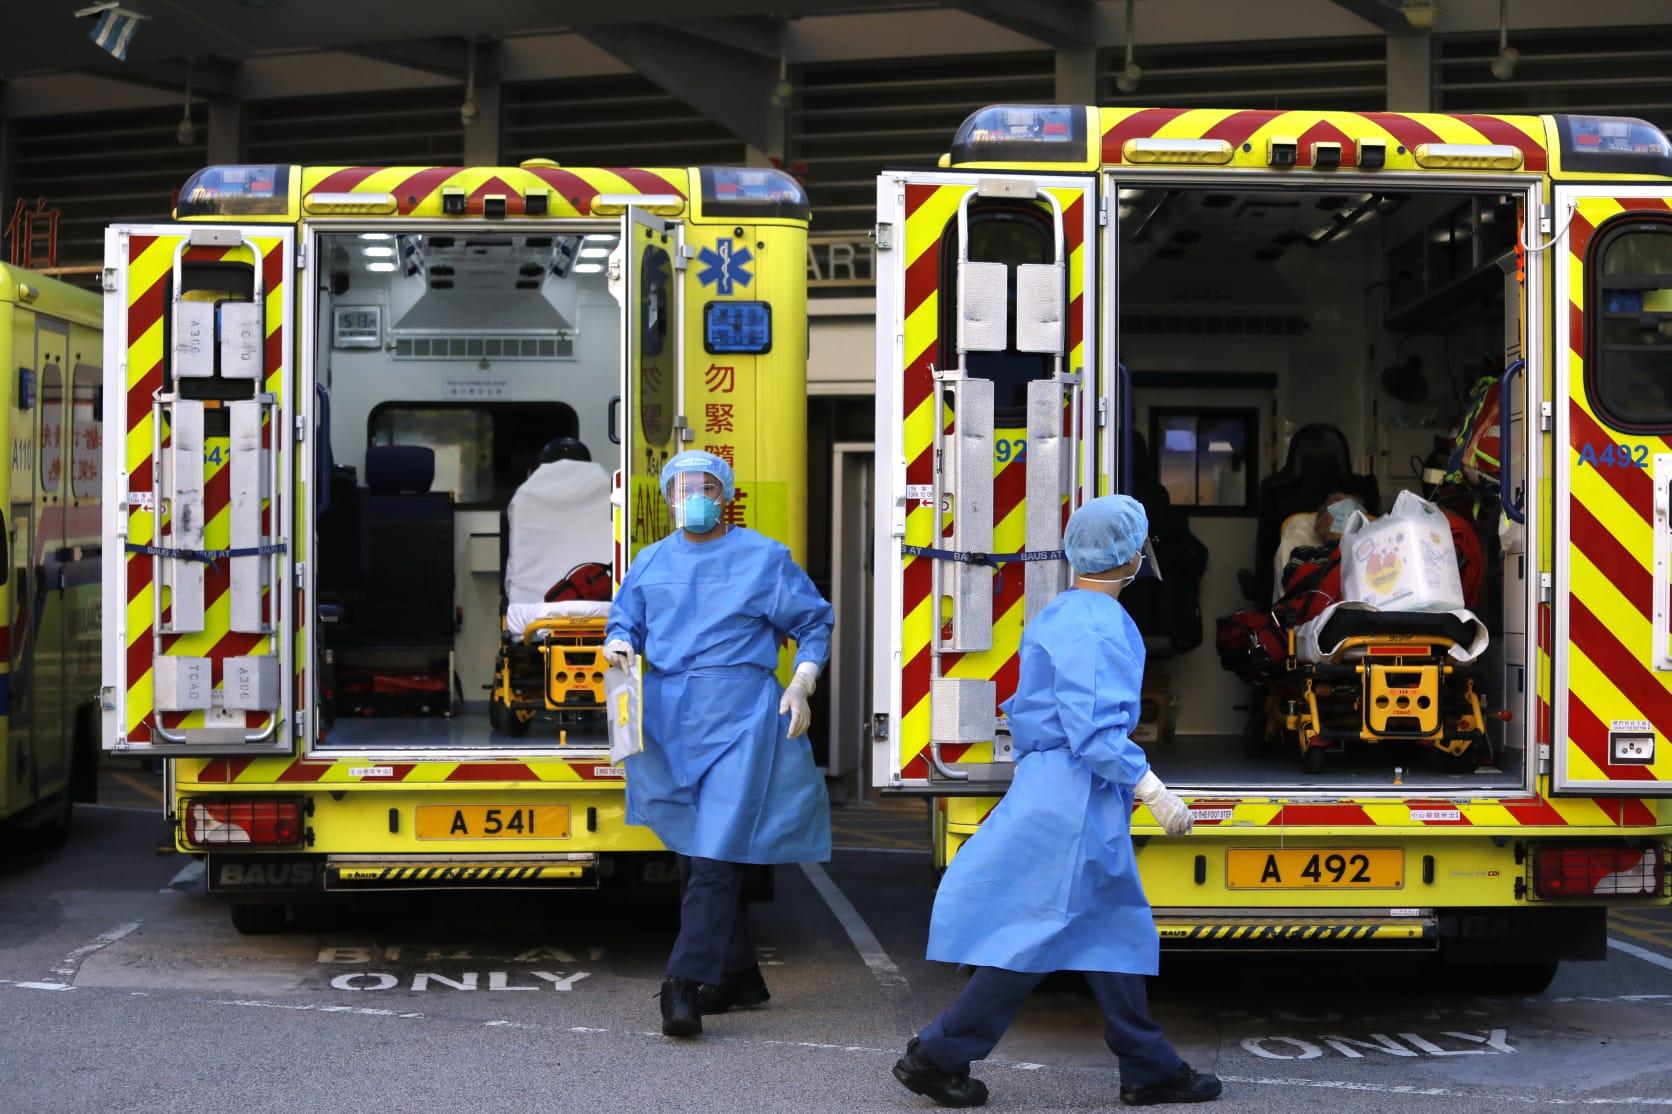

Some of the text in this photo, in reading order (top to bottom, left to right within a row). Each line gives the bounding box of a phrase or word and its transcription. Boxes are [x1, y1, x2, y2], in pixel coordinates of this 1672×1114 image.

[995, 439, 1027, 463] 92
[1577, 443, 1648, 468] A492
[909, 546, 922, 555] AT
[1020, 550, 1063, 561] BAUS AT
[450, 809, 535, 835] A 541
[219, 861, 314, 885] BAUS
[1260, 854, 1371, 883] A 492
[331, 971, 591, 991] ONLY
[1240, 1028, 1519, 1060] ONLY
